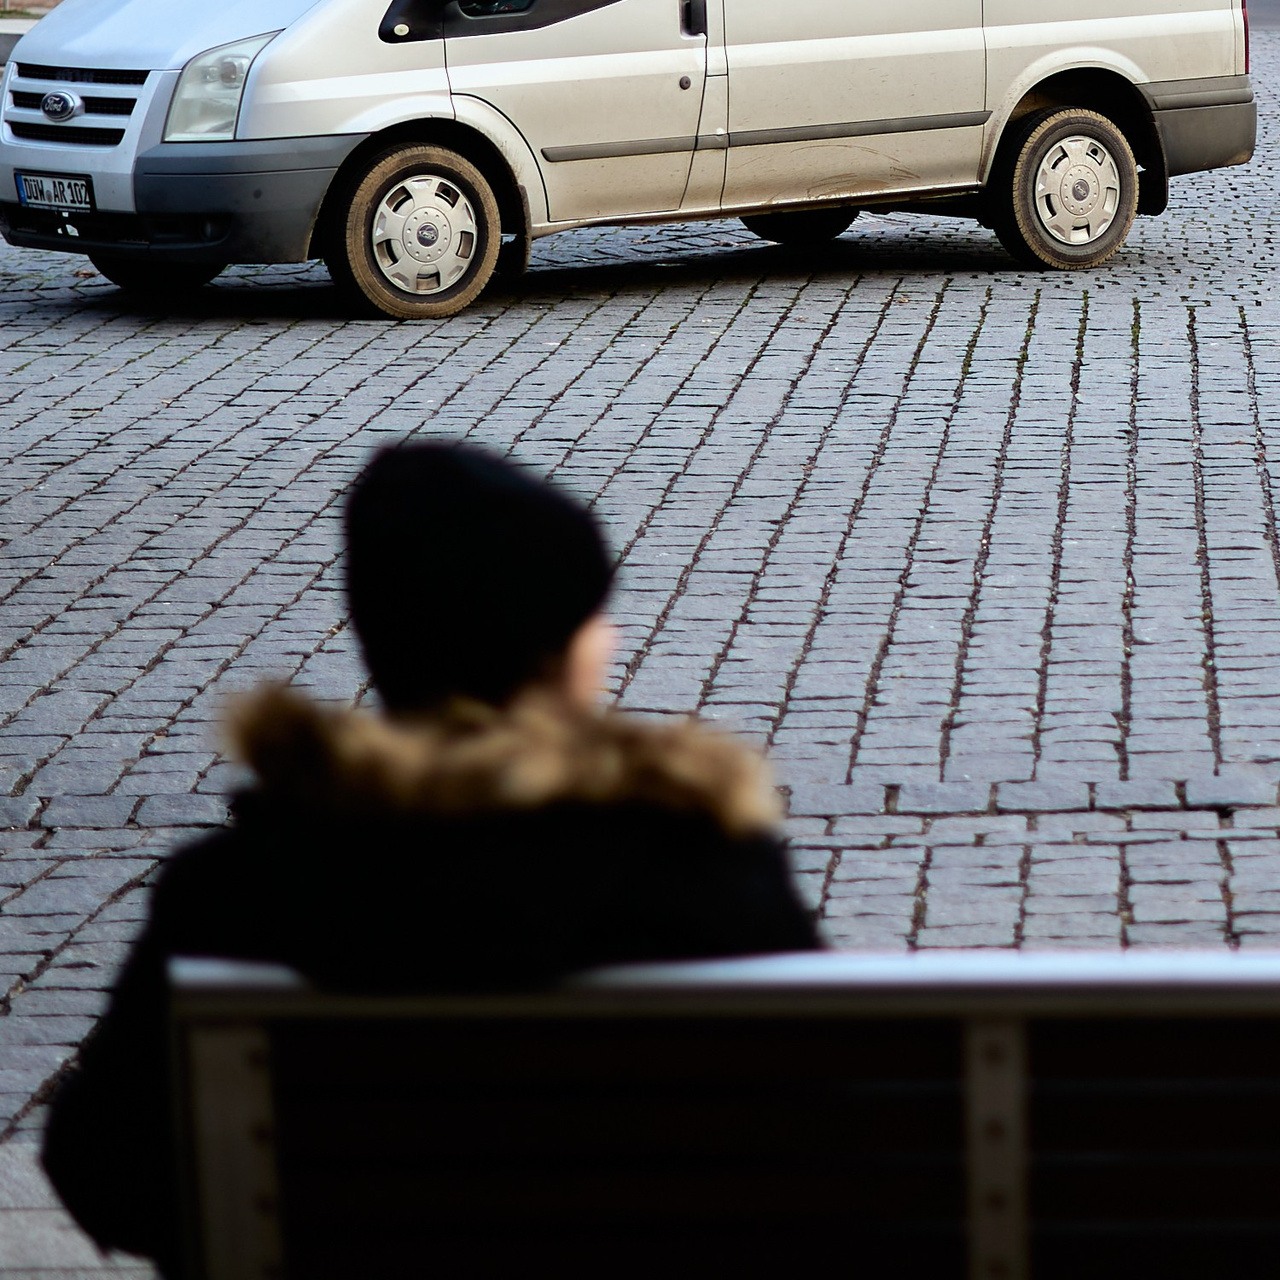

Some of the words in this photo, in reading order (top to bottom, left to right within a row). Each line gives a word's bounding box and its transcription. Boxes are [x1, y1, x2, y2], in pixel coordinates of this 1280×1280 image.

[44, 95, 65, 112] Ford
[23, 177, 46, 202] DÜW
[52, 180, 68, 204] AR
[67, 183, 91, 206] 102
